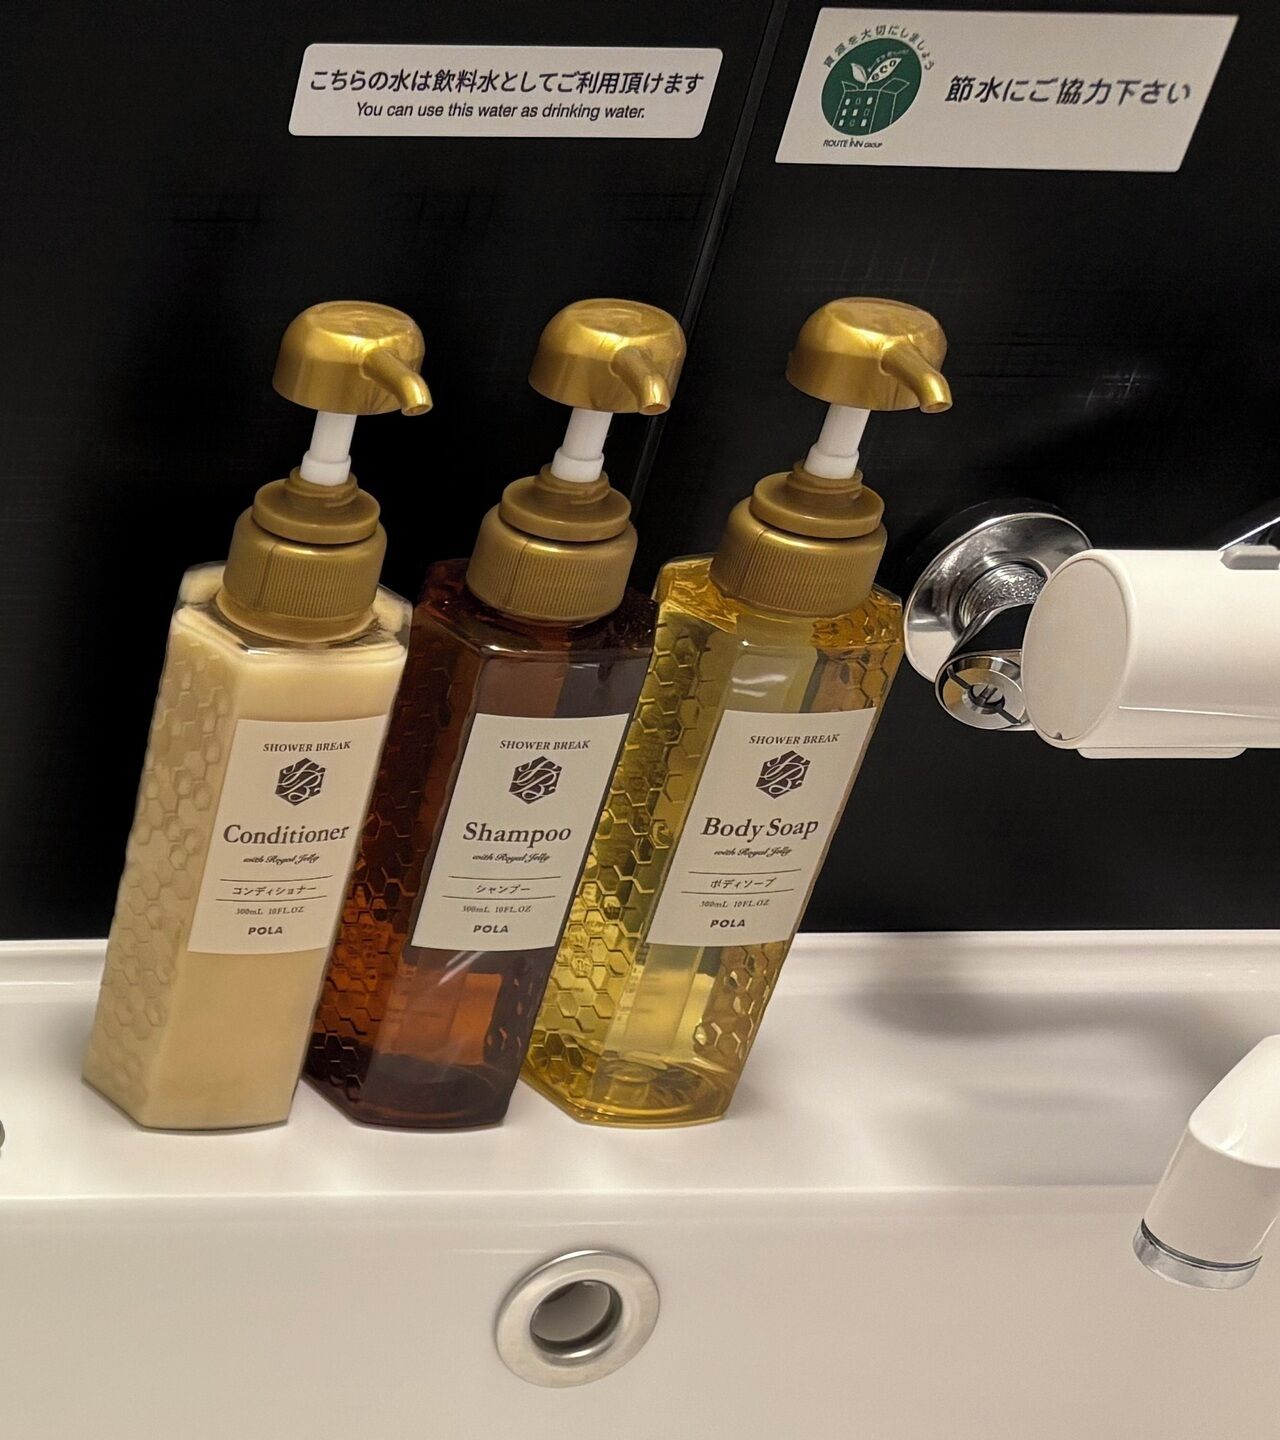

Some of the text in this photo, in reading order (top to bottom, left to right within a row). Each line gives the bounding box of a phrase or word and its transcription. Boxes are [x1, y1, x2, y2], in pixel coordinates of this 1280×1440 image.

[310, 68, 704, 94] こちらの水は飲料水としてご利用頂けます
[944, 74, 1192, 106] 節水にご協力下さい
[357, 101, 646, 121] You can use this water as drinking water.
[823, 139, 848, 148] ROUTE
[499, 739, 591, 750] SHOWER BREAK
[748, 733, 841, 746] SHOWER BREAK
[263, 740, 352, 752] SHOWER BREAK
[223, 824, 350, 845] Conditioner
[462, 821, 572, 849] Shampoo
[700, 816, 819, 843] Body Soap
[472, 852, 551, 864] with Royal Jelly
[714, 846, 793, 859] with Royal Jelly
[243, 853, 320, 865] with Royal Jelly
[475, 884, 531, 894] シャンプー
[710, 877, 777, 889] ボディソープ
[232, 886, 317, 896] コンディショナー
[472, 925, 509, 934] POLA
[709, 919, 746, 928] POLA
[247, 926, 283, 936] POLA
